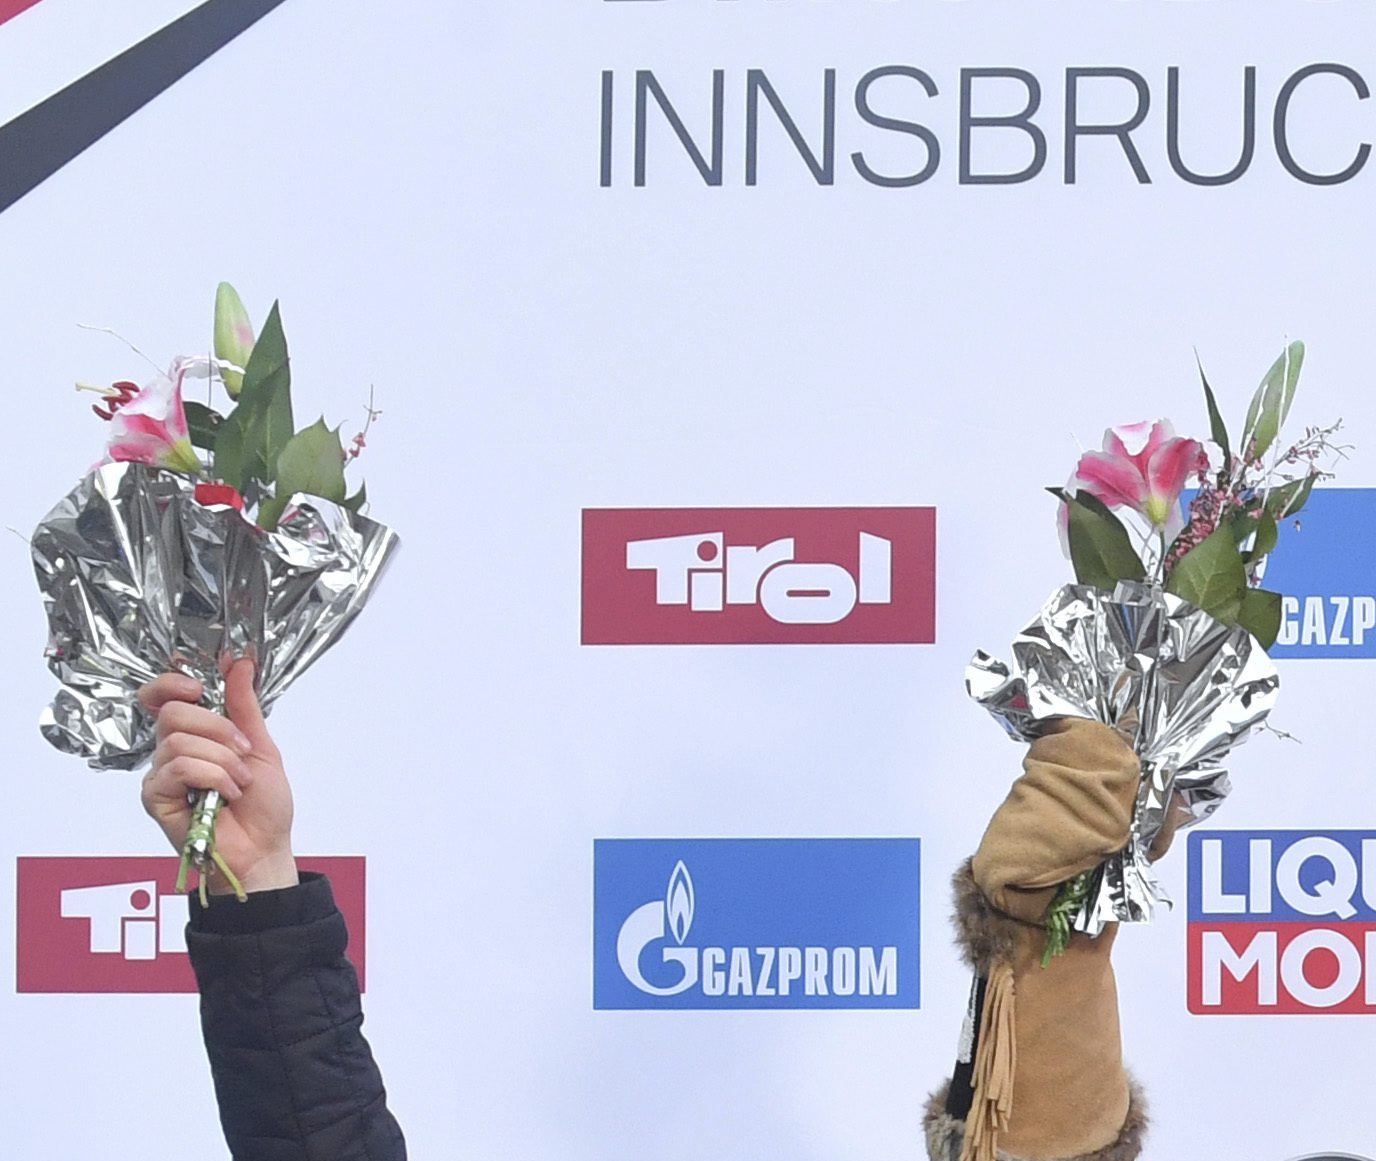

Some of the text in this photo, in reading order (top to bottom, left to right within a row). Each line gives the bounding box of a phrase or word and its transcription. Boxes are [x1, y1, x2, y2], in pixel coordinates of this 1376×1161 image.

[626, 531, 892, 624] Tirol
[60, 880, 190, 960] Tir
[701, 946, 898, 997] GAZPROM
